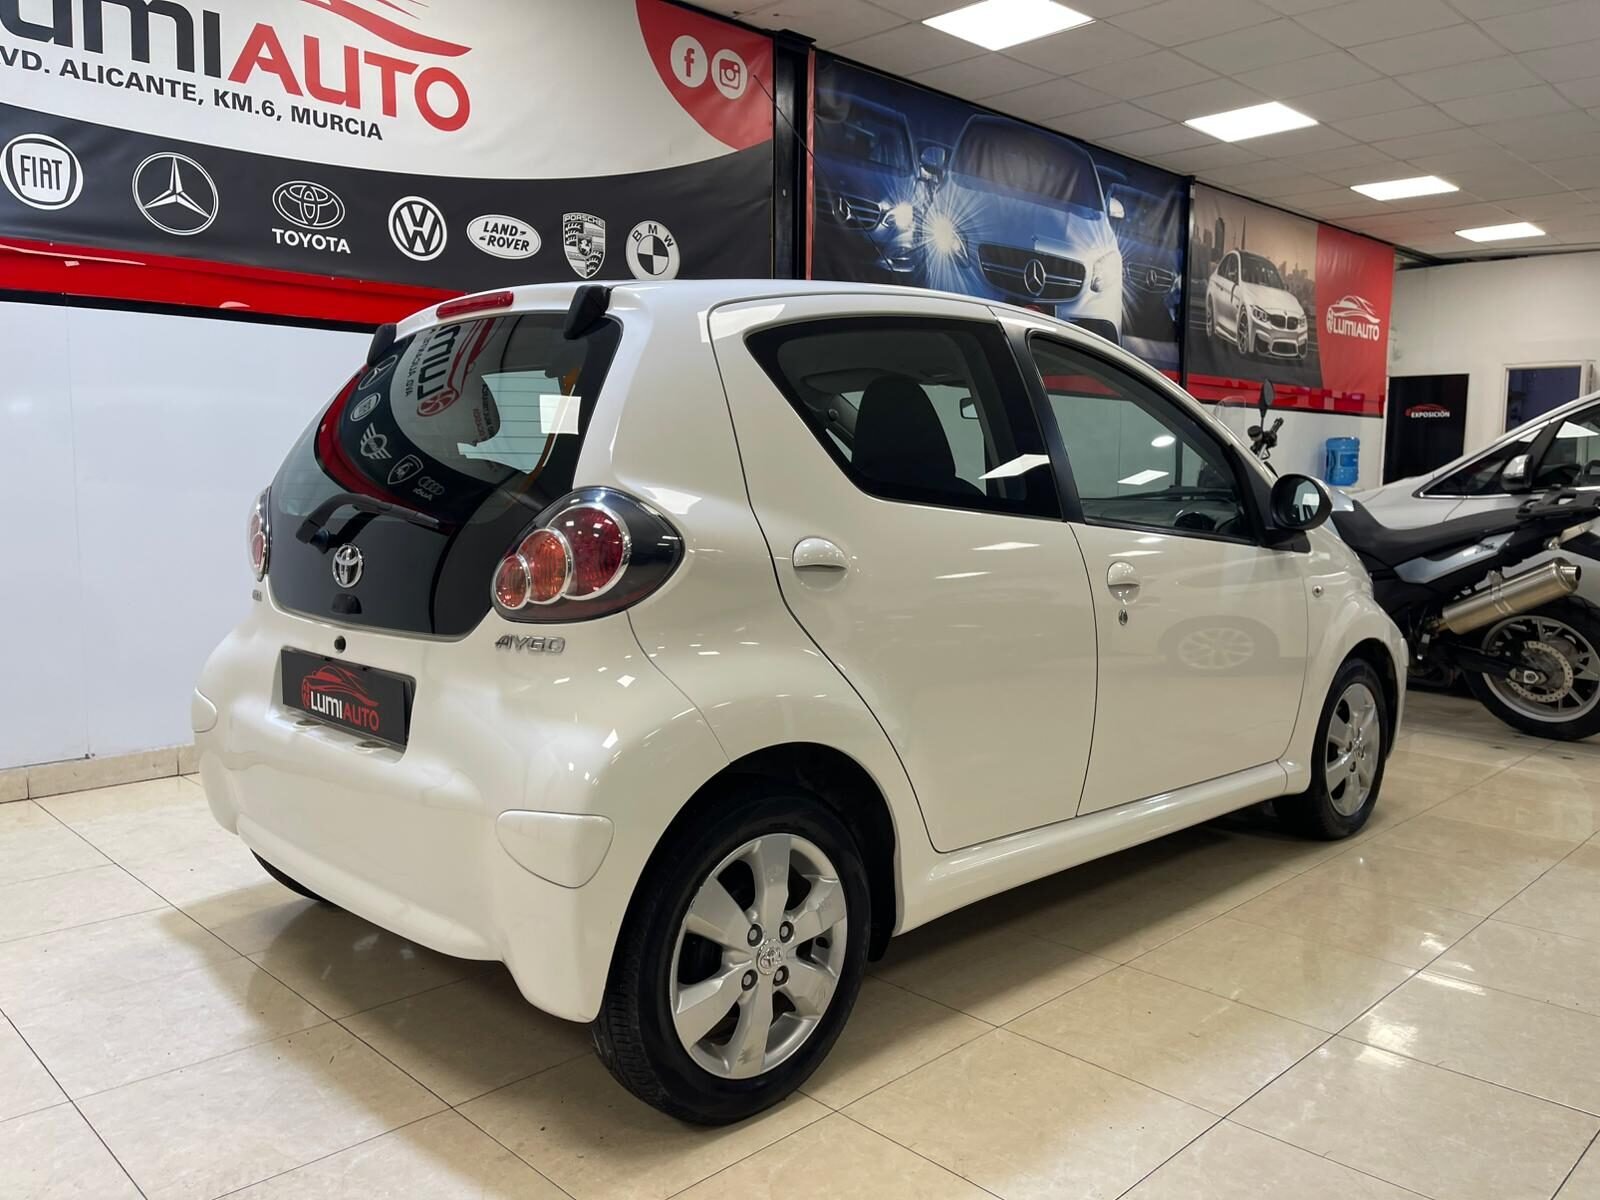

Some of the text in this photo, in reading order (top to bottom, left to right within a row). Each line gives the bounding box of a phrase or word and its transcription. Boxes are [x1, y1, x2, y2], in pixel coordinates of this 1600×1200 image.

[58, 58, 205, 106] ALICANTE,
[213, 88, 283, 122] KM.6,
[290, 105, 383, 141] MURCIA
[19, 154, 63, 192] FIAT
[272, 228, 351, 254] TOYOTA
[494, 634, 567, 653] AYGO
